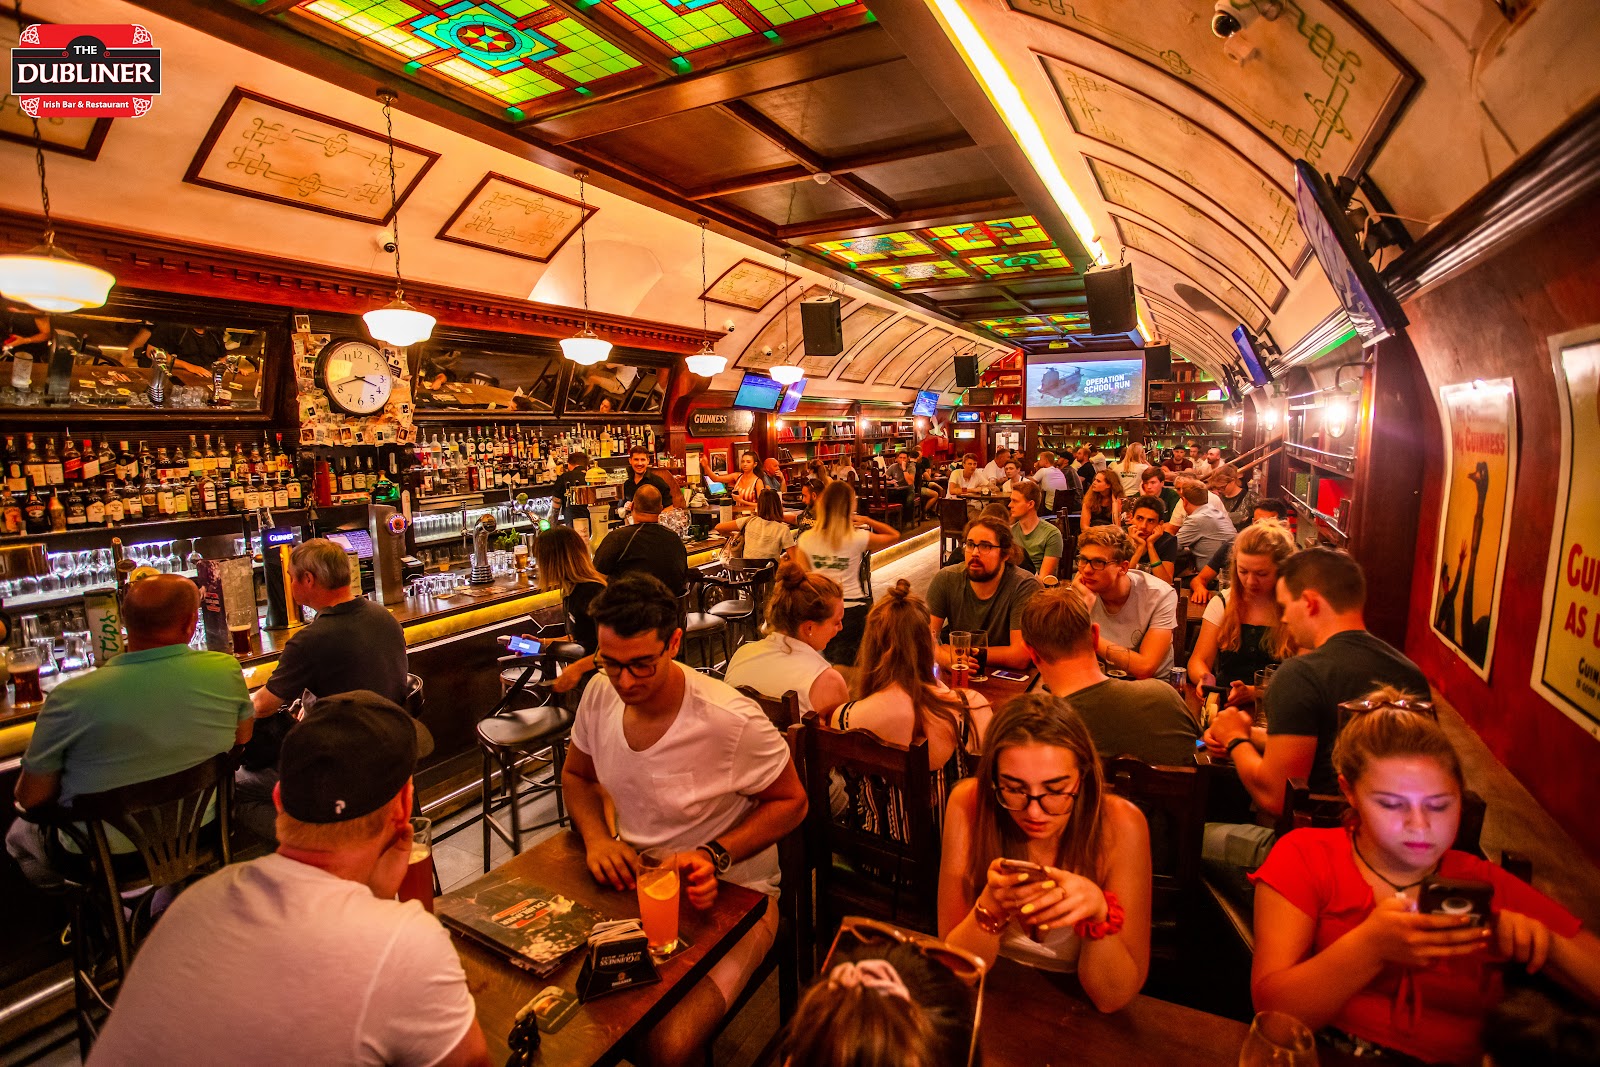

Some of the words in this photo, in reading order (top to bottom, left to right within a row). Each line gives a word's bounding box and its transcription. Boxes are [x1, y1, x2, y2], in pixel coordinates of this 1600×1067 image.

[344, 354, 352, 362] 11
[353, 351, 363, 360] 12
[374, 363, 380, 371] 2
[379, 375, 385, 383] 3
[1085, 374, 1125, 387] OPERATION
[337, 385, 344, 394] 8
[376, 386, 382, 394] 4
[1083, 383, 1114, 394] SCHOOL
[1114, 380, 1131, 390] RUN
[348, 394, 353, 403] 7
[357, 397, 364, 406] 6
[370, 394, 375, 403] 5
[694, 413, 728, 424] GUINNESS
[1466, 427, 1505, 456] GUINNESS
[1564, 601, 1588, 639] AS
